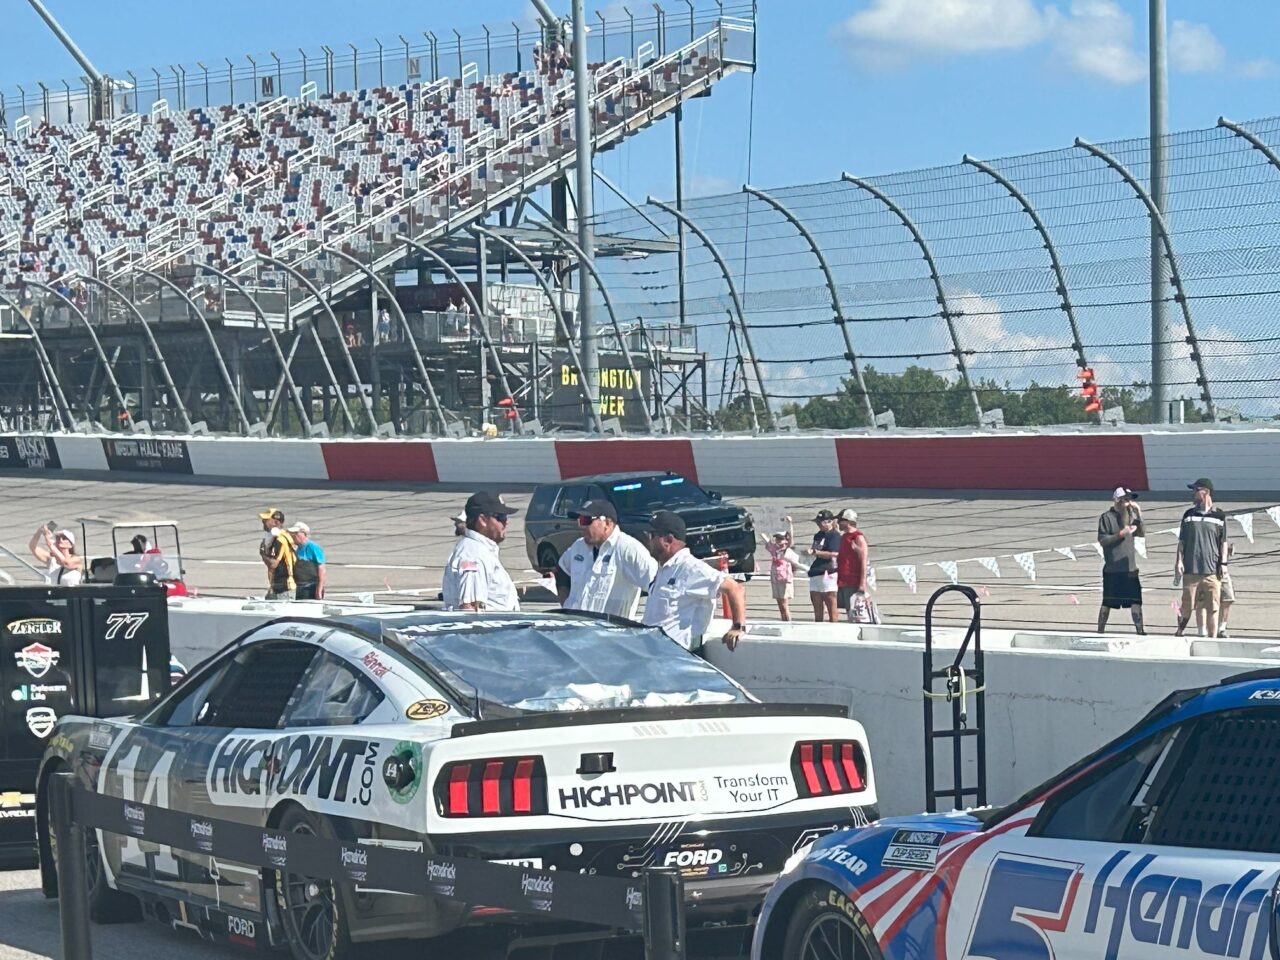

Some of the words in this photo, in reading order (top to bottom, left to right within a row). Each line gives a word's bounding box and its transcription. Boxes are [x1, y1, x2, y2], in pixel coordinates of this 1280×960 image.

[105, 612, 149, 640] 77
[714, 773, 789, 788] Transform
[558, 781, 697, 809] HIGHPOINT
[729, 788, 762, 803] Your
[767, 787, 780, 801] IT
[664, 849, 723, 867] FORD
[426, 860, 456, 880] Hendrick
[521, 873, 554, 896] Hendrick
[829, 889, 871, 940] EAGLE
[228, 915, 255, 938] FORD
